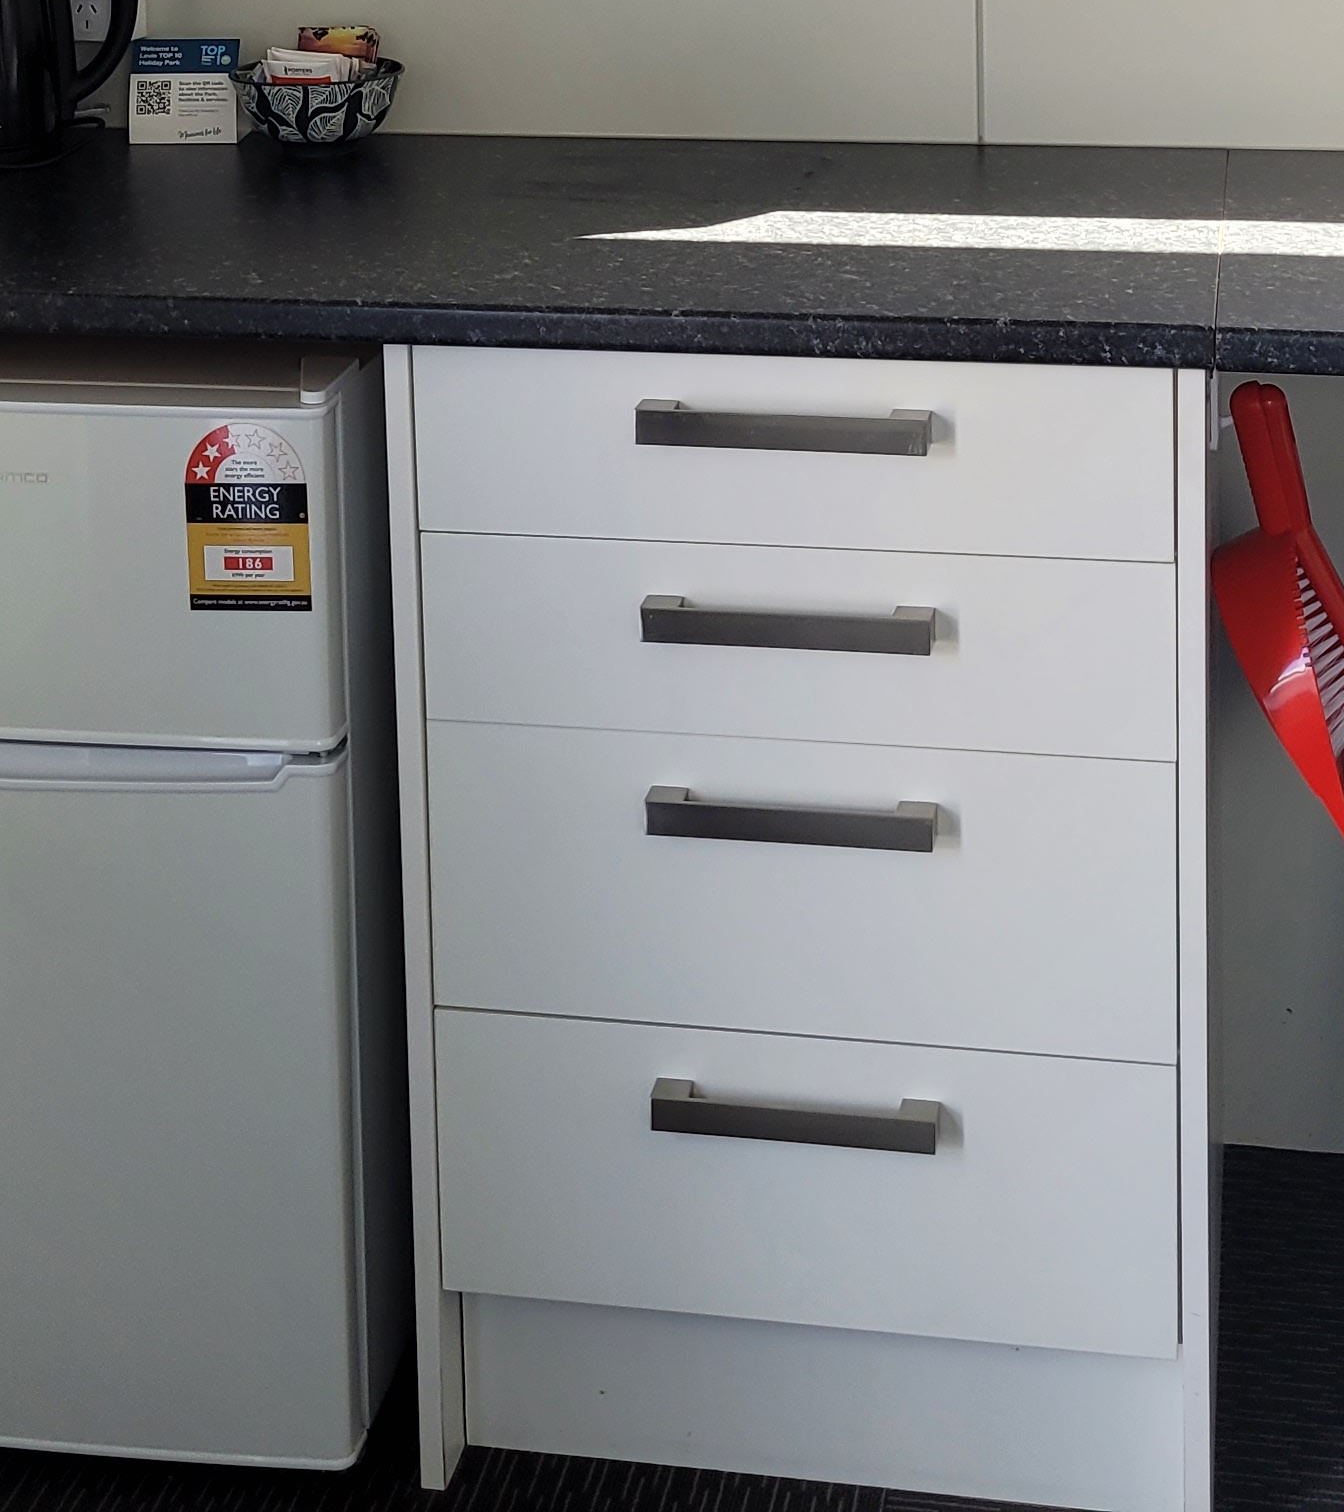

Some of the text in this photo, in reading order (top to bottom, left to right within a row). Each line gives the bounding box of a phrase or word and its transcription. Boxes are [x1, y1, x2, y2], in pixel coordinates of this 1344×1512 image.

[200, 45, 225, 55] TOP
[209, 486, 281, 502] ENERGY
[212, 503, 280, 519] RATING
[238, 557, 263, 569] 186
[193, 598, 217, 606] Compare
